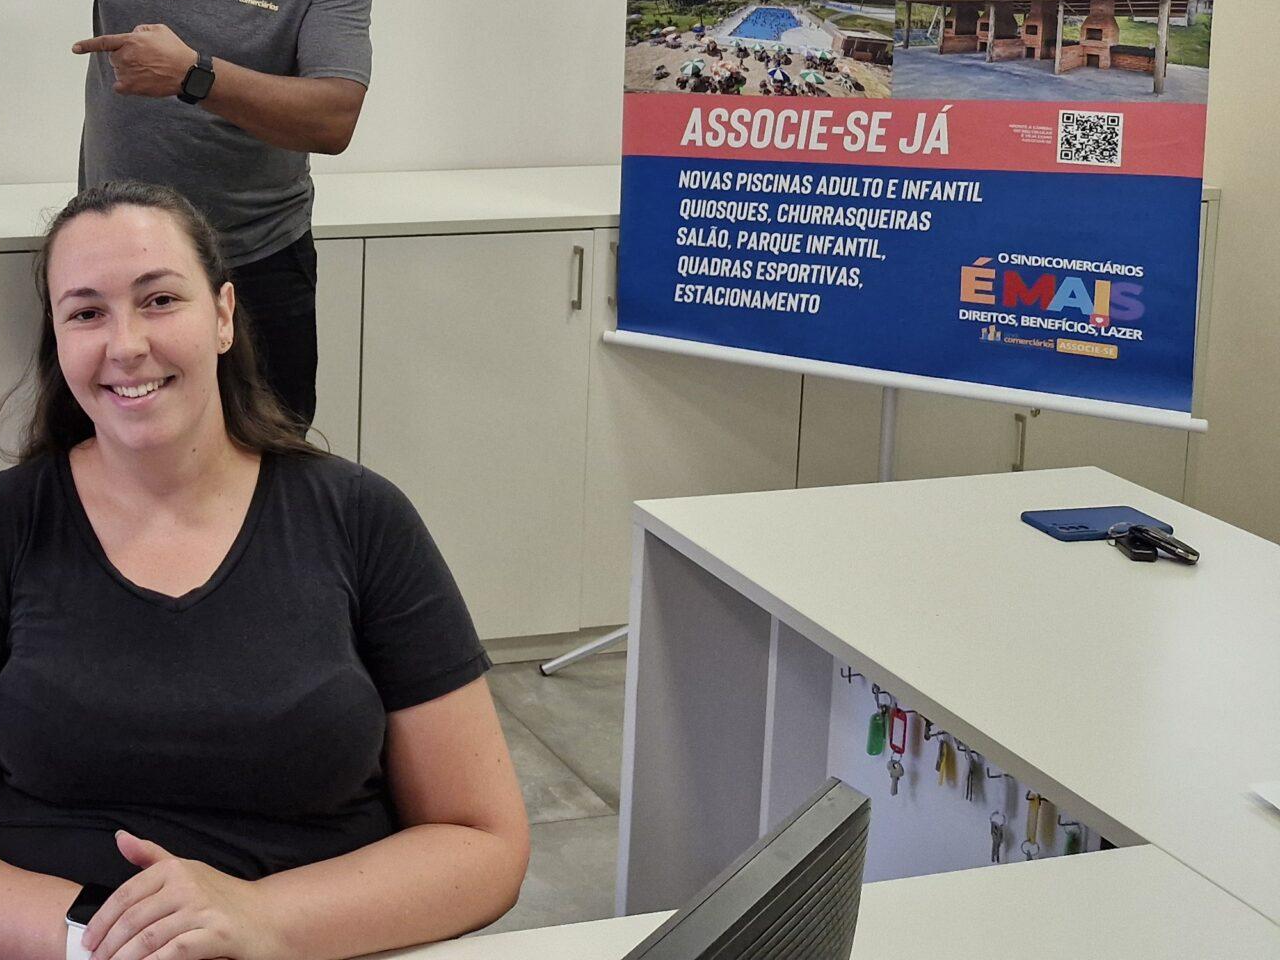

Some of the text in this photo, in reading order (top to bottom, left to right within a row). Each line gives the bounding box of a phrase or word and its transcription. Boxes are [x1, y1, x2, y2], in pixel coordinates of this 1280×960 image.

[680, 107, 892, 153] ASSOCIE-SE
[898, 104, 953, 155] JÁ
[678, 170, 983, 202] NOVAS PISCINAS ADULTO E INFANTIL
[679, 198, 932, 231] QUIOSQUES, CHURRASQUEIRAS
[676, 226, 887, 261] SALÃO, PARQUE INFANTIL,
[677, 255, 864, 290] QUADRAS ESPORTIVAS,
[997, 252, 1144, 278] O SINDICOMERCIÁRIOS
[674, 283, 821, 314] ESTACIONAMENTO
[960, 257, 1145, 321] É MAIS
[958, 309, 1019, 327] DIREITOS,
[1020, 315, 1099, 337] BENEFÍCIOS,
[1101, 325, 1143, 340] LAZER
[1059, 341, 1115, 357] ASSOCIE-SE
